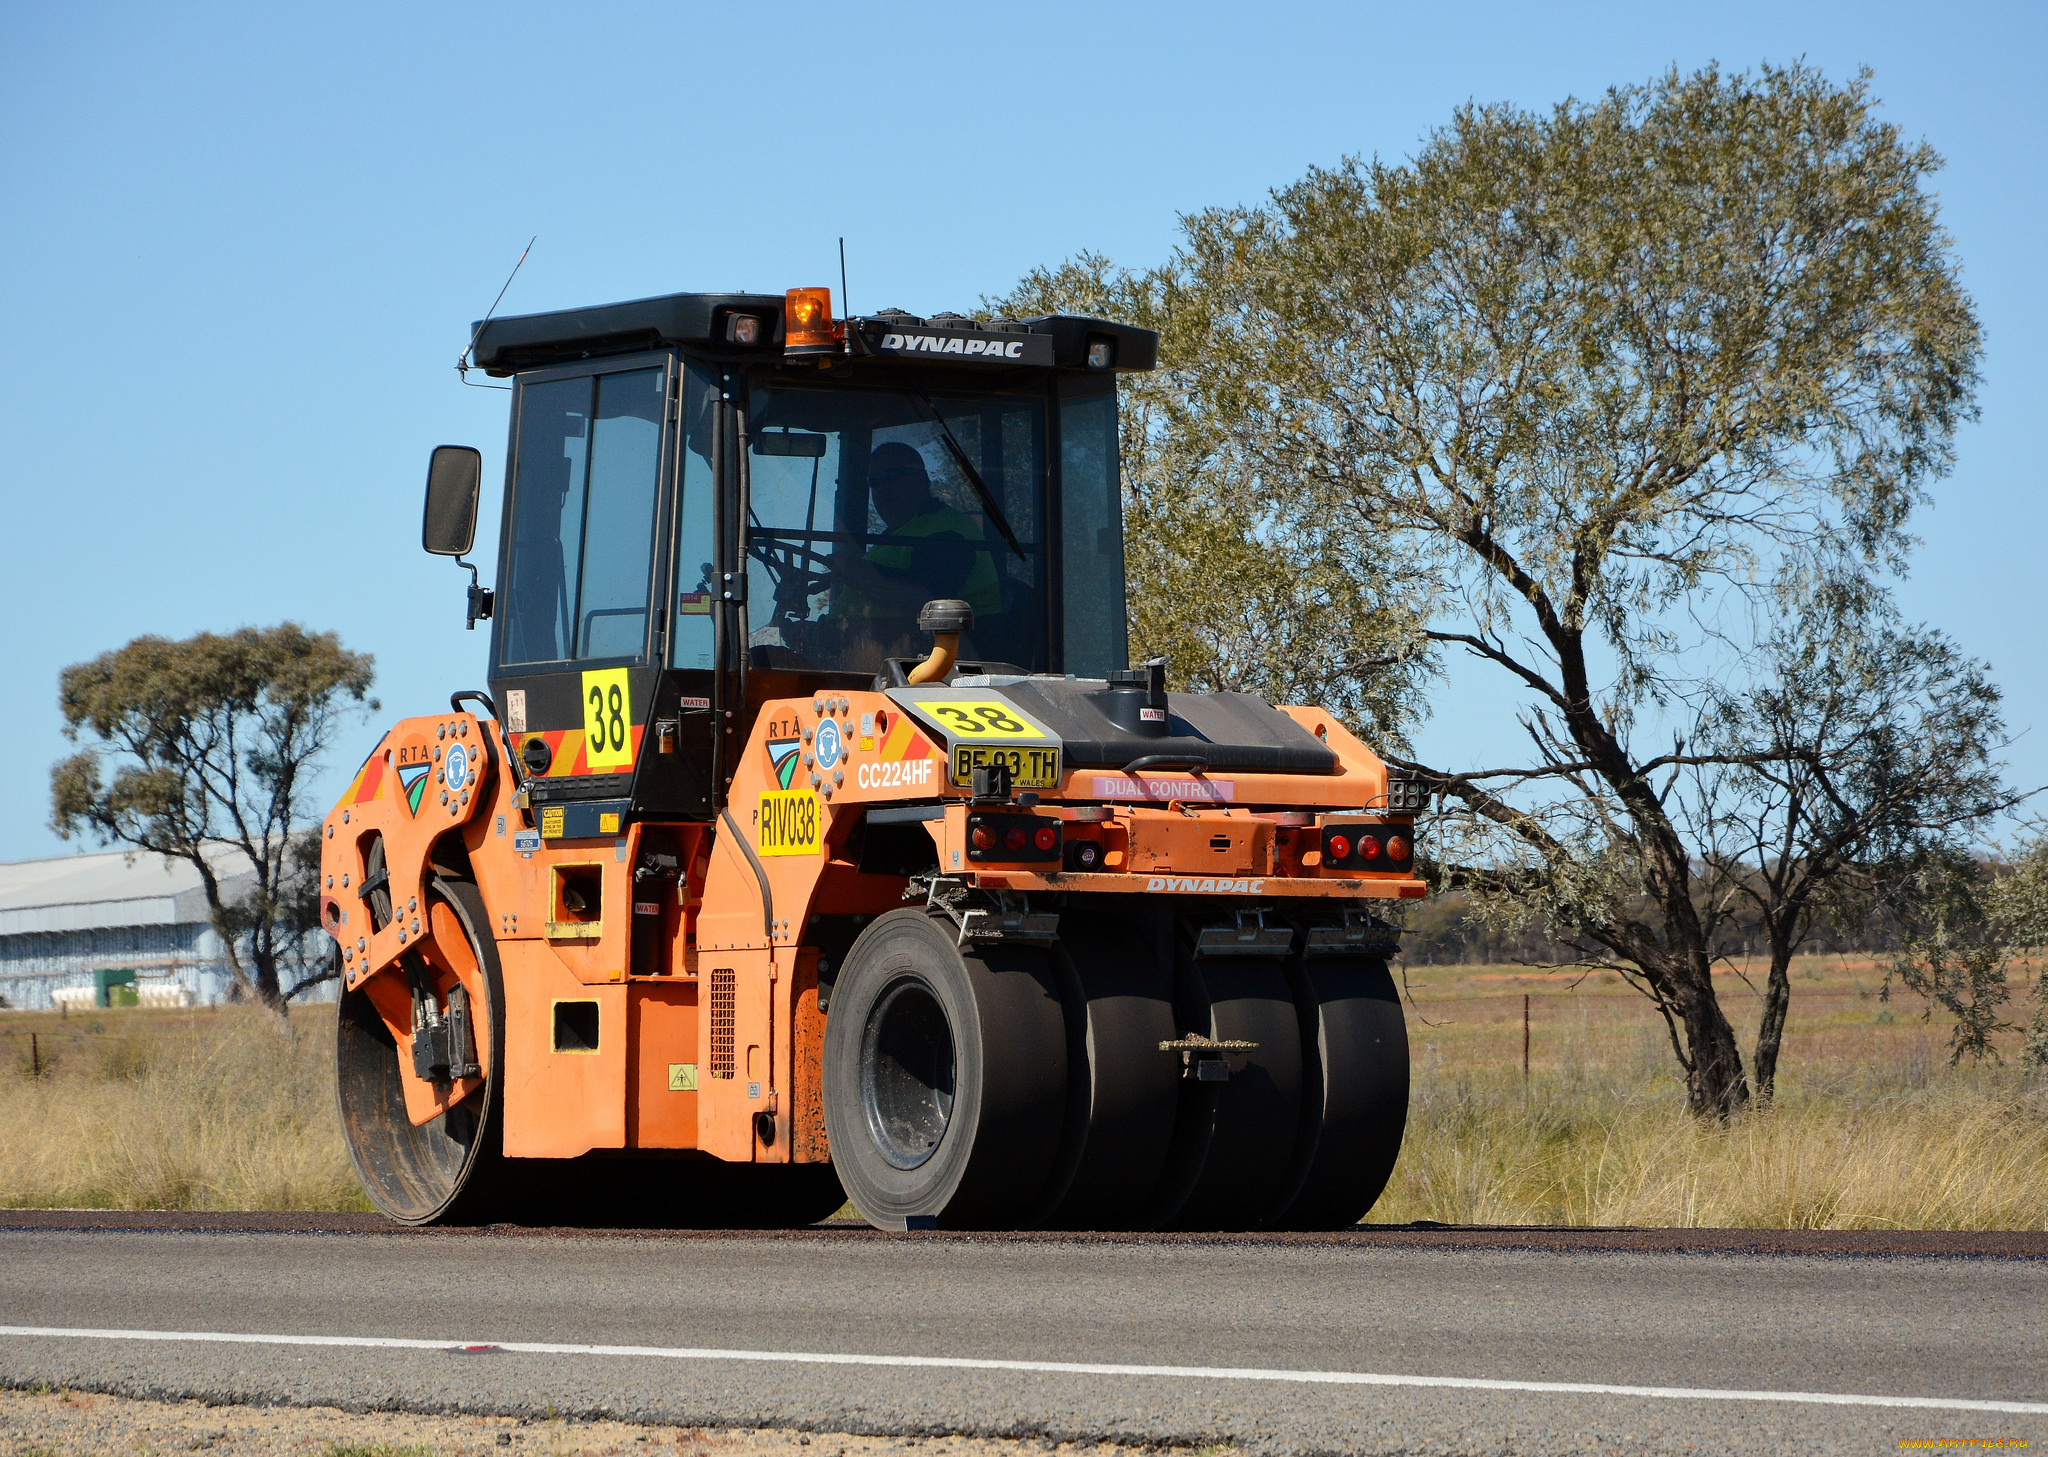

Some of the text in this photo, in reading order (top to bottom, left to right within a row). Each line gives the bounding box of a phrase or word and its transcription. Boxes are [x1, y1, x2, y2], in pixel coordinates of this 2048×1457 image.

[881, 334, 1024, 358] DYNAPAC
[683, 698, 708, 706] WATER
[589, 684, 625, 753] 38
[936, 707, 1025, 732] 38
[1143, 710, 1164, 719] WATER
[769, 718, 801, 738] RTA
[400, 744, 429, 763] RTA
[858, 759, 933, 789] CC224HF
[1019, 779, 1045, 787] WALES
[1104, 779, 1221, 798] DUAL CONTROL
[761, 796, 815, 846] RIV038
[1147, 878, 1265, 894] DYNAPAC
